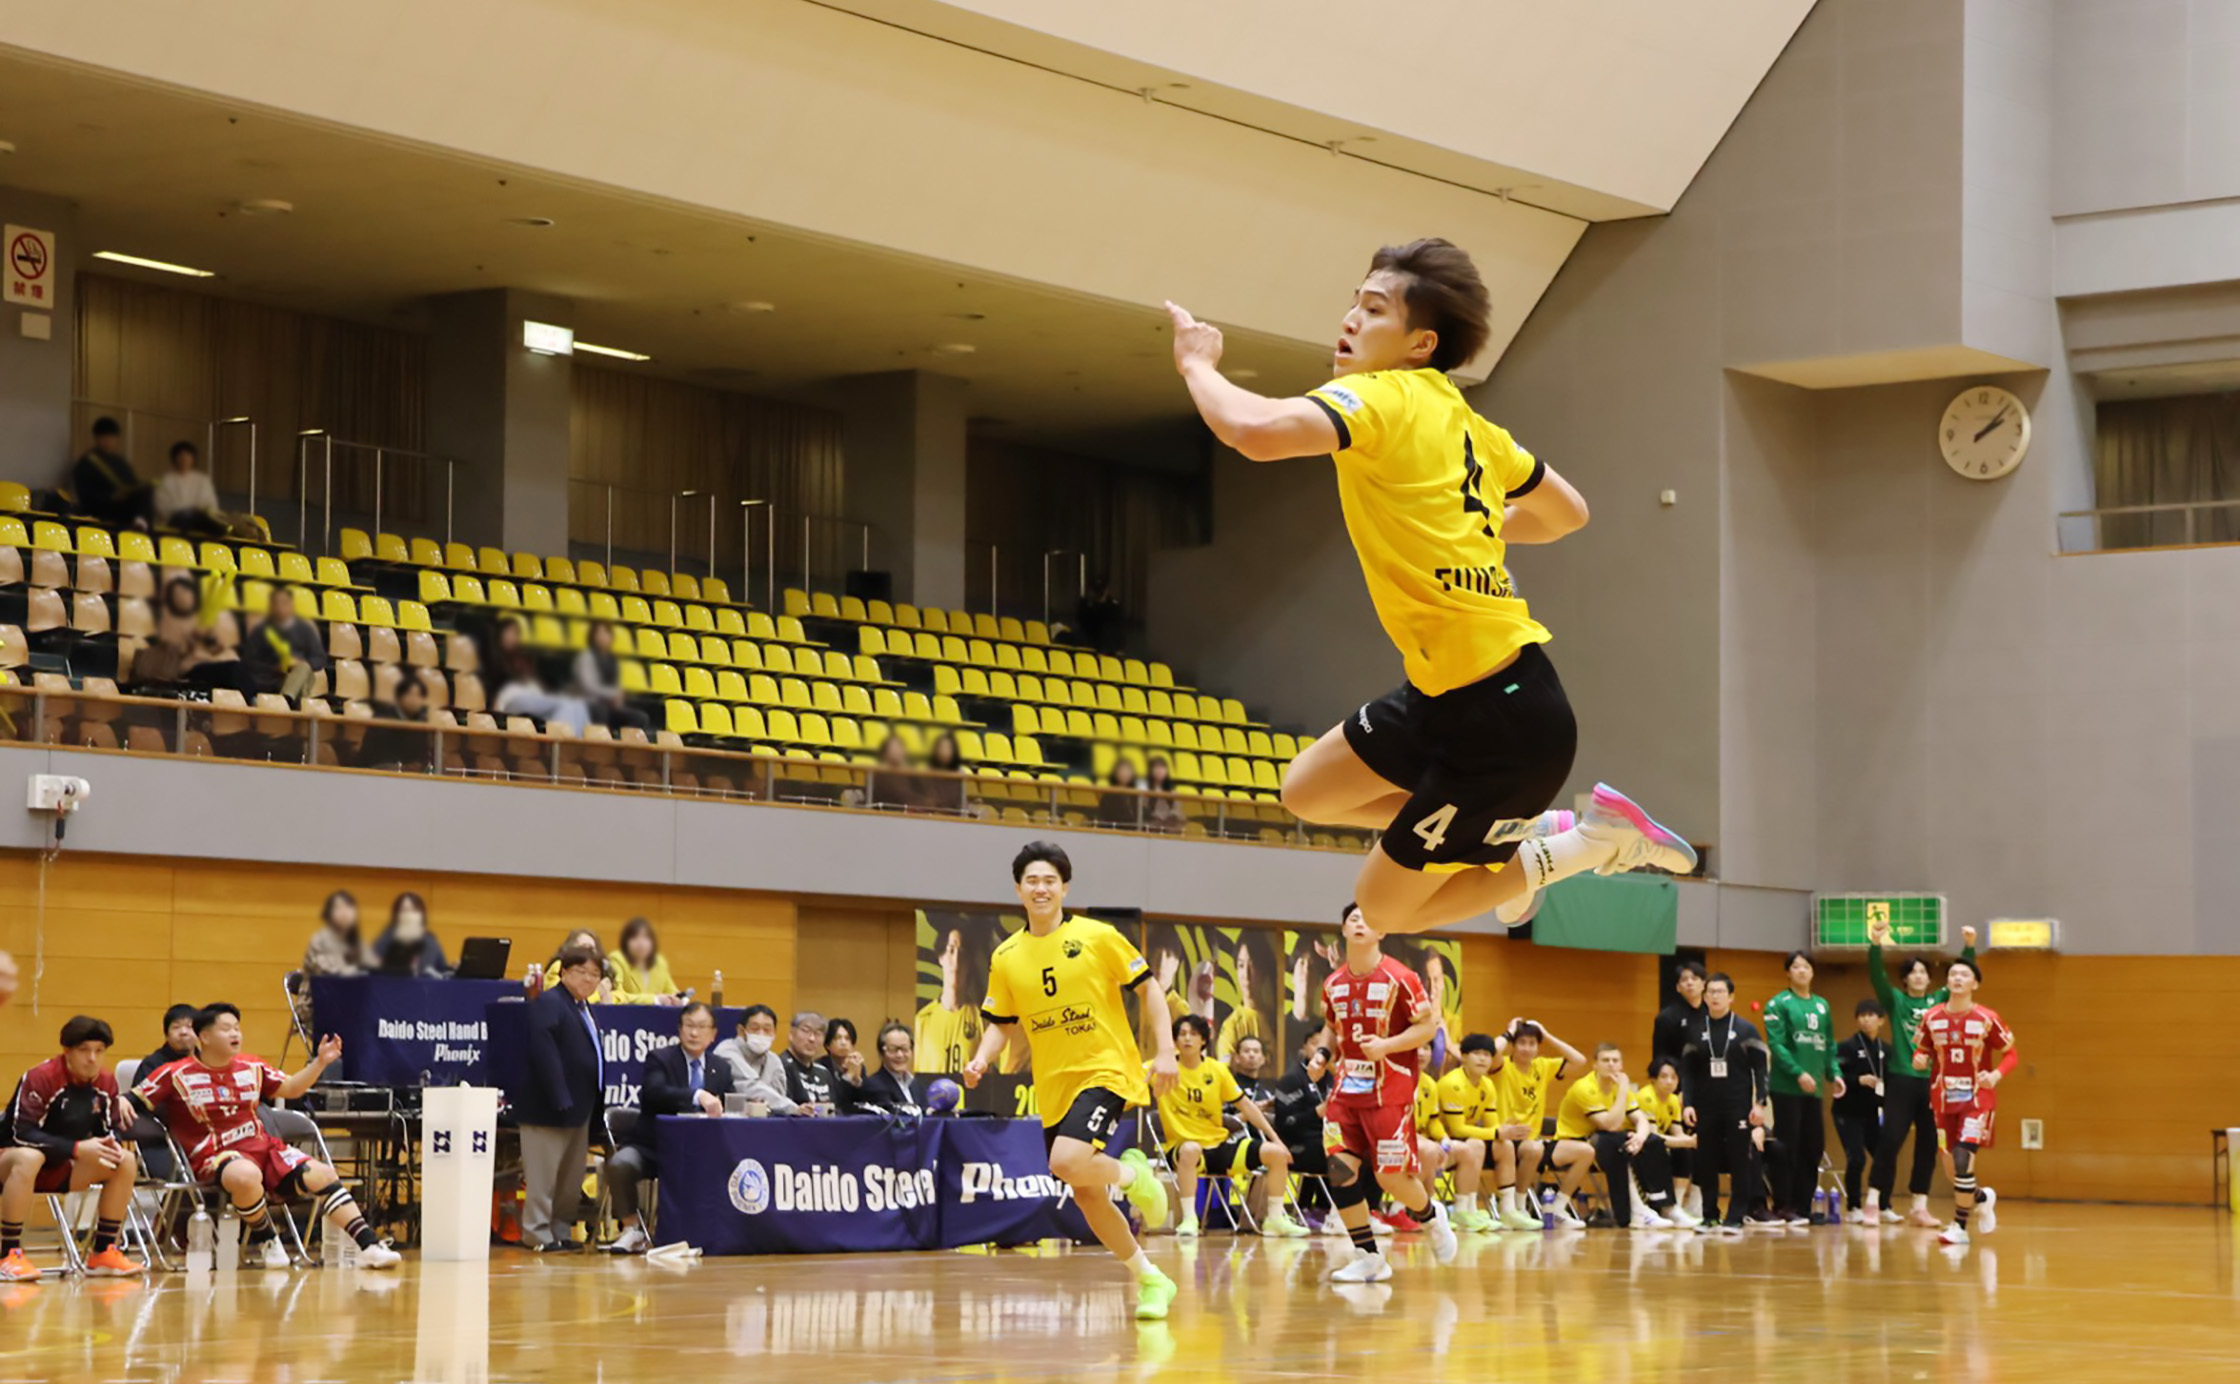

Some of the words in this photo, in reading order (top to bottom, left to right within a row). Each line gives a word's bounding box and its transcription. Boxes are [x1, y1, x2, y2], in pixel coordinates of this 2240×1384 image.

[1460, 429, 1496, 538] 4
[1412, 803, 1459, 852] 4
[1042, 966, 1057, 997] 5
[378, 1018, 415, 1040] Daido
[416, 1020, 447, 1041] Steel
[448, 1021, 479, 1041] Hand
[1352, 1022, 1364, 1043] 2
[1087, 1105, 1108, 1132] 5
[774, 1162, 860, 1213] Daido
